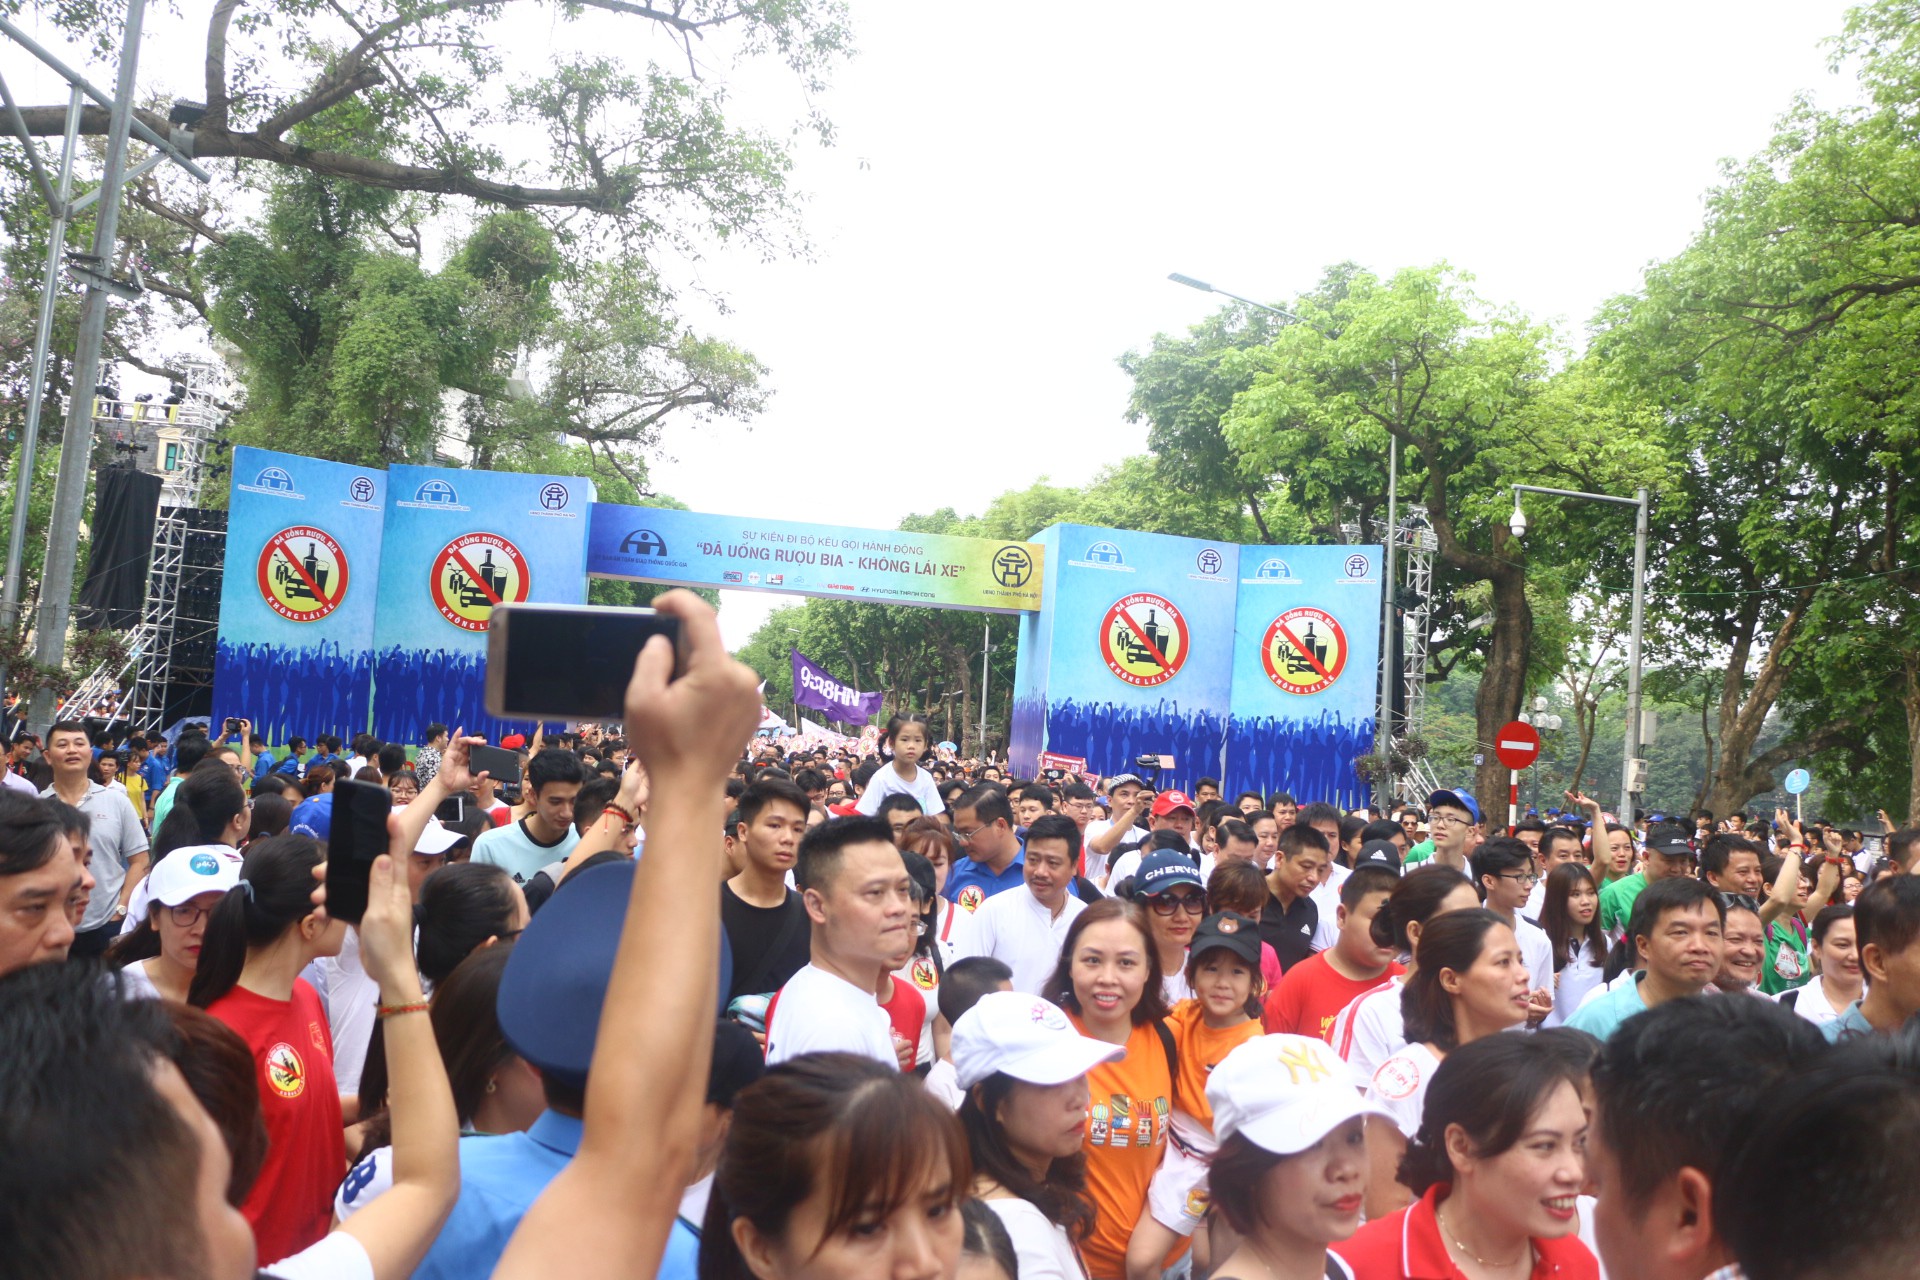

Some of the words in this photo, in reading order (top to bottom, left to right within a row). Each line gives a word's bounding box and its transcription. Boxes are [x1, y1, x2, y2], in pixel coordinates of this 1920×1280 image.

[326, 541, 338, 554] BIA
[504, 546, 518, 559] BIA
[742, 530, 758, 542] SỰ
[760, 531, 784, 543] KIỆN
[787, 535, 797, 544] ĐI
[800, 535, 814, 546] BỘ
[818, 535, 838, 548] KÊU
[842, 540, 859, 550] GỌI
[862, 540, 890, 552] HÀNH
[894, 543, 924, 555] ĐỘNG
[728, 542, 770, 560] UỐNG
[775, 548, 816, 566] RƯỢU
[820, 552, 844, 567] BIA
[858, 556, 910, 573] KHÔNG
[914, 560, 936, 576] LÁI
[268, 596, 299, 619] KHÔNG
[303, 612, 320, 620] LÁI
[322, 603, 334, 614] XE
[441, 606, 475, 629] KHÔNG
[1166, 607, 1178, 619] BIA
[1325, 618, 1336, 629] BIA
[1109, 662, 1140, 684] KHÔNG
[1144, 676, 1161, 684] LÁI
[1164, 667, 1176, 678] XE
[1271, 673, 1300, 693] KHÔNG
[1304, 685, 1321, 693] LÁI
[1322, 675, 1334, 686] XE
